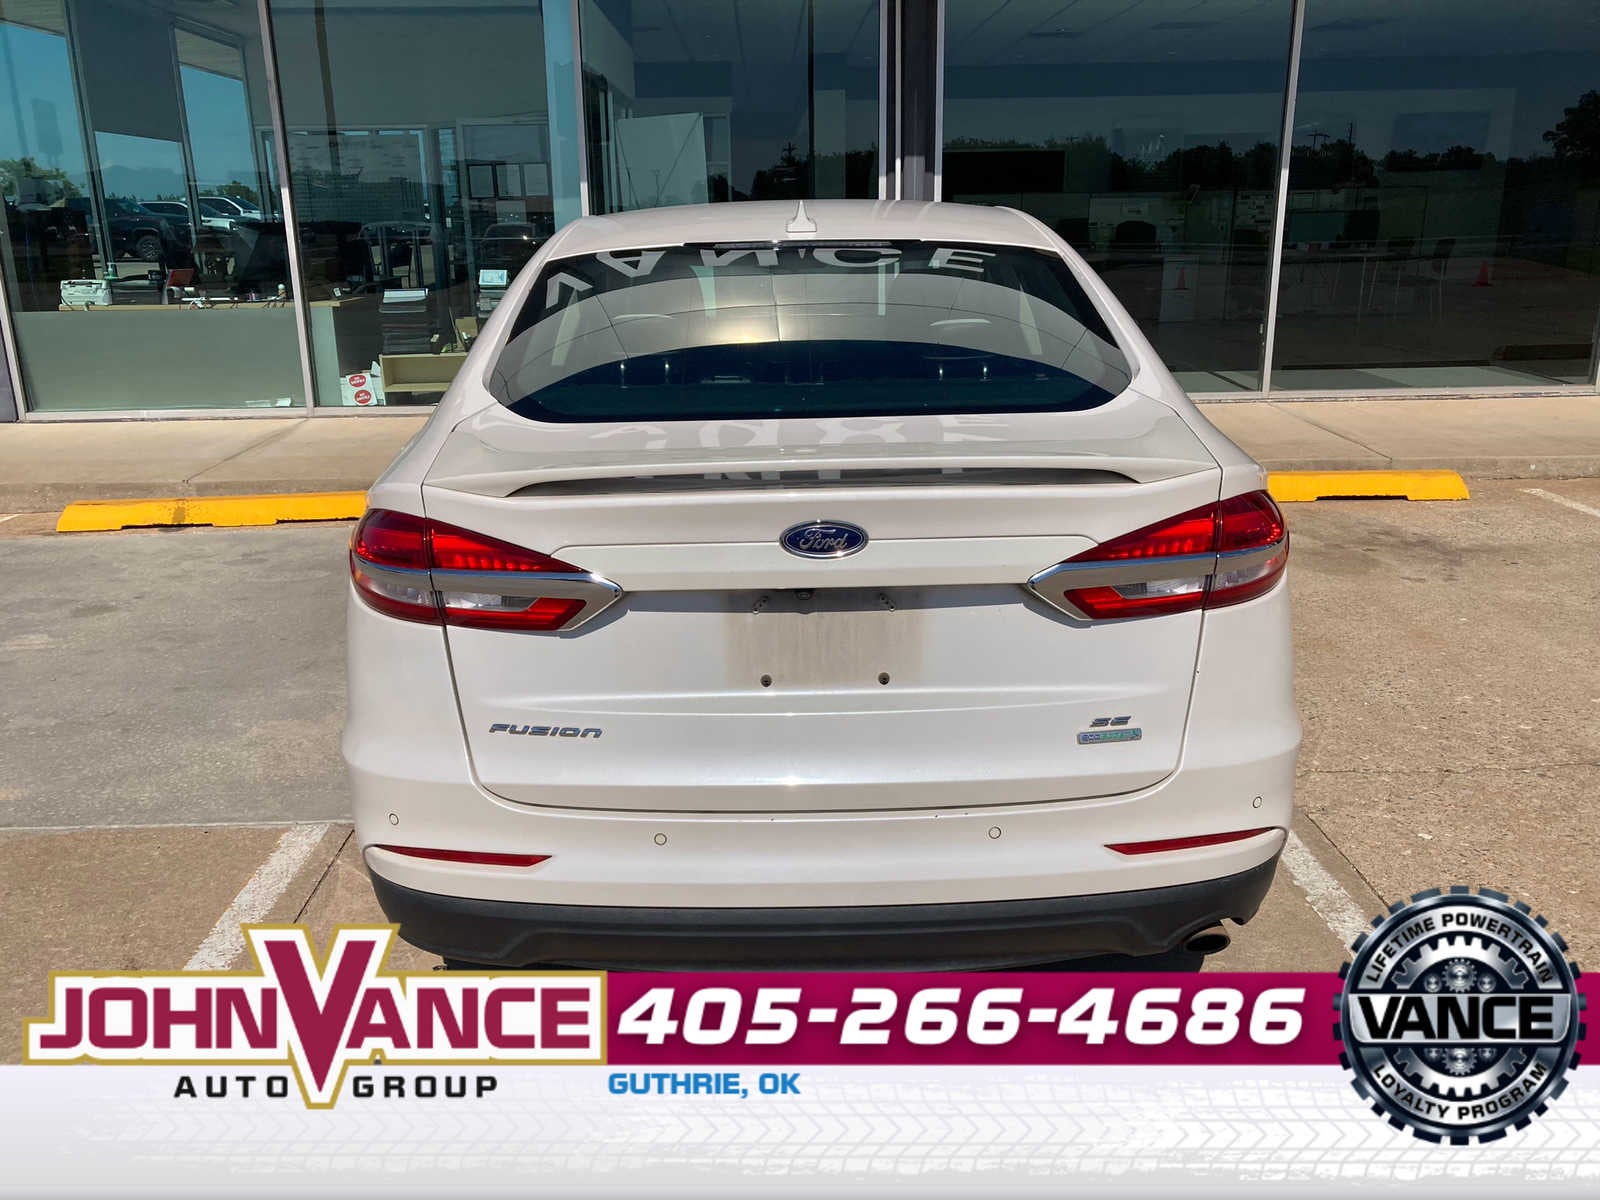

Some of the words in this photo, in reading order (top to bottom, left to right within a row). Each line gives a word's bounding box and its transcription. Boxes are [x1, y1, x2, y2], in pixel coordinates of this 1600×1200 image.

[799, 528, 848, 550] Ford
[1089, 715, 1132, 727] SE
[488, 723, 602, 738] FUSION
